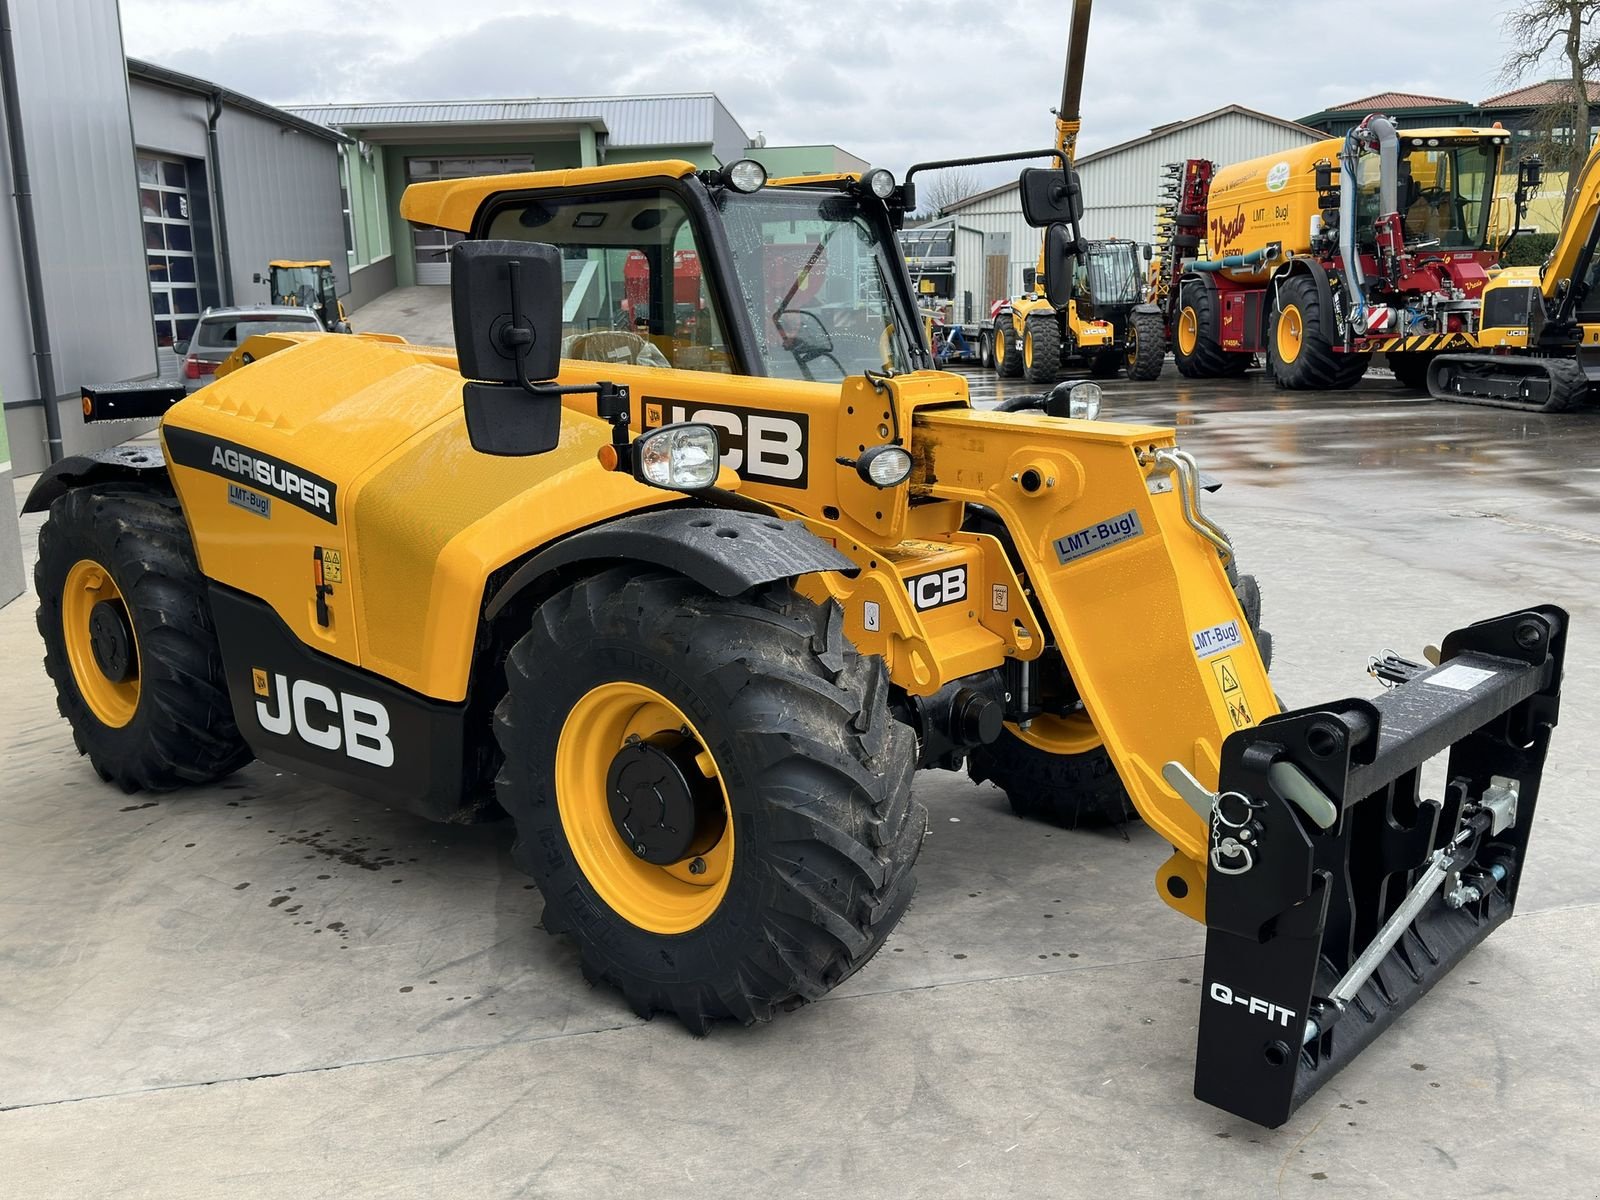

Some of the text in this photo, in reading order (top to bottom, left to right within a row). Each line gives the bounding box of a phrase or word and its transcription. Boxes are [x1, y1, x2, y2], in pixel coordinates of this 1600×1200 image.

[1210, 203, 1246, 255] Vredo
[1252, 204, 1289, 222] LMT Bugl
[211, 445, 331, 514] AGRISUPER
[230, 484, 269, 513] LMT-Bugl
[1058, 513, 1136, 555] LMT-Bugl
[1192, 622, 1239, 651] LMT-Bugl
[255, 673, 395, 768] JCB
[1210, 982, 1296, 1027] Q-FIT
